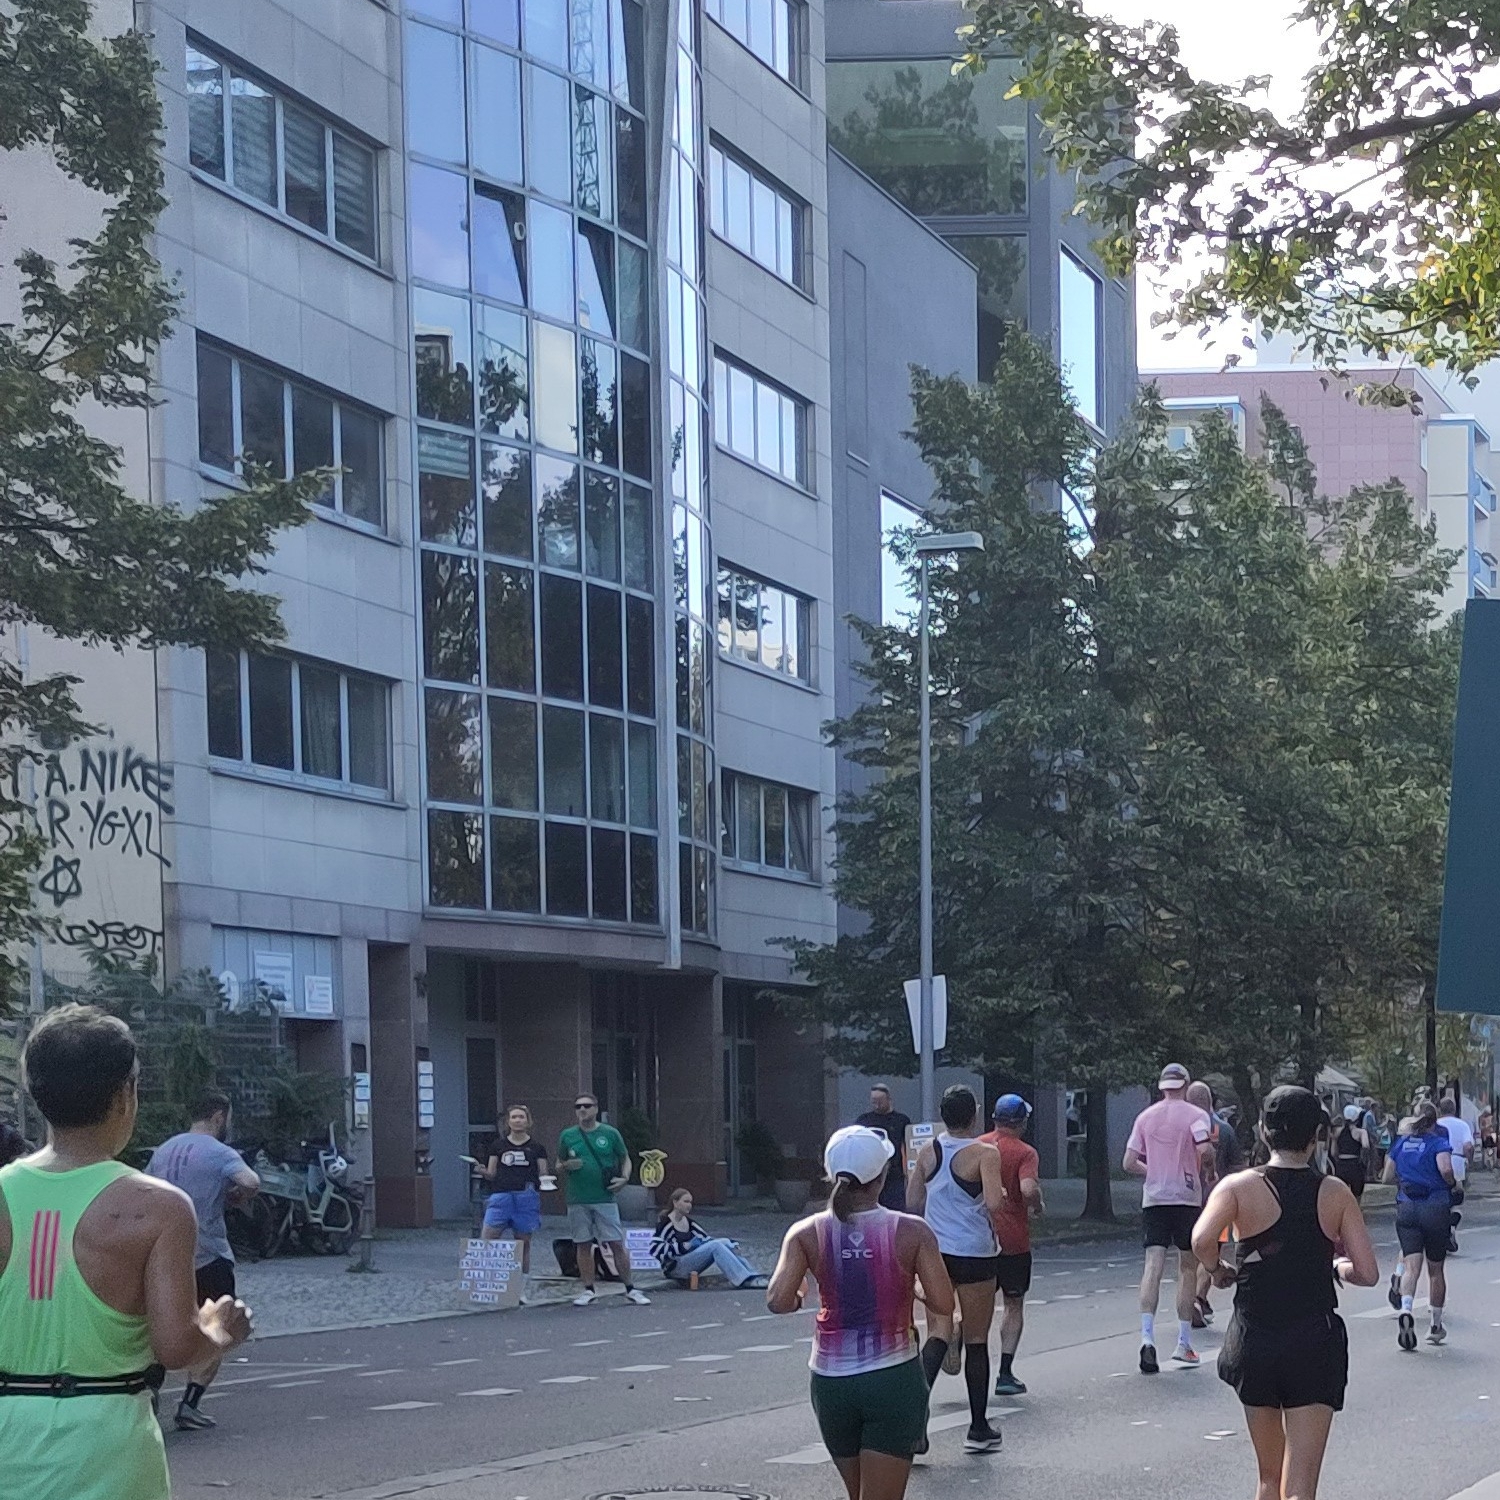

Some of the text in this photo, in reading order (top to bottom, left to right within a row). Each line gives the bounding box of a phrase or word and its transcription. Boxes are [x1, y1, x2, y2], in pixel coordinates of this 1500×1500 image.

[470, 1241, 484, 1249] MY
[465, 1251, 515, 1259] HUSBAND
[841, 1249, 874, 1259] STC
